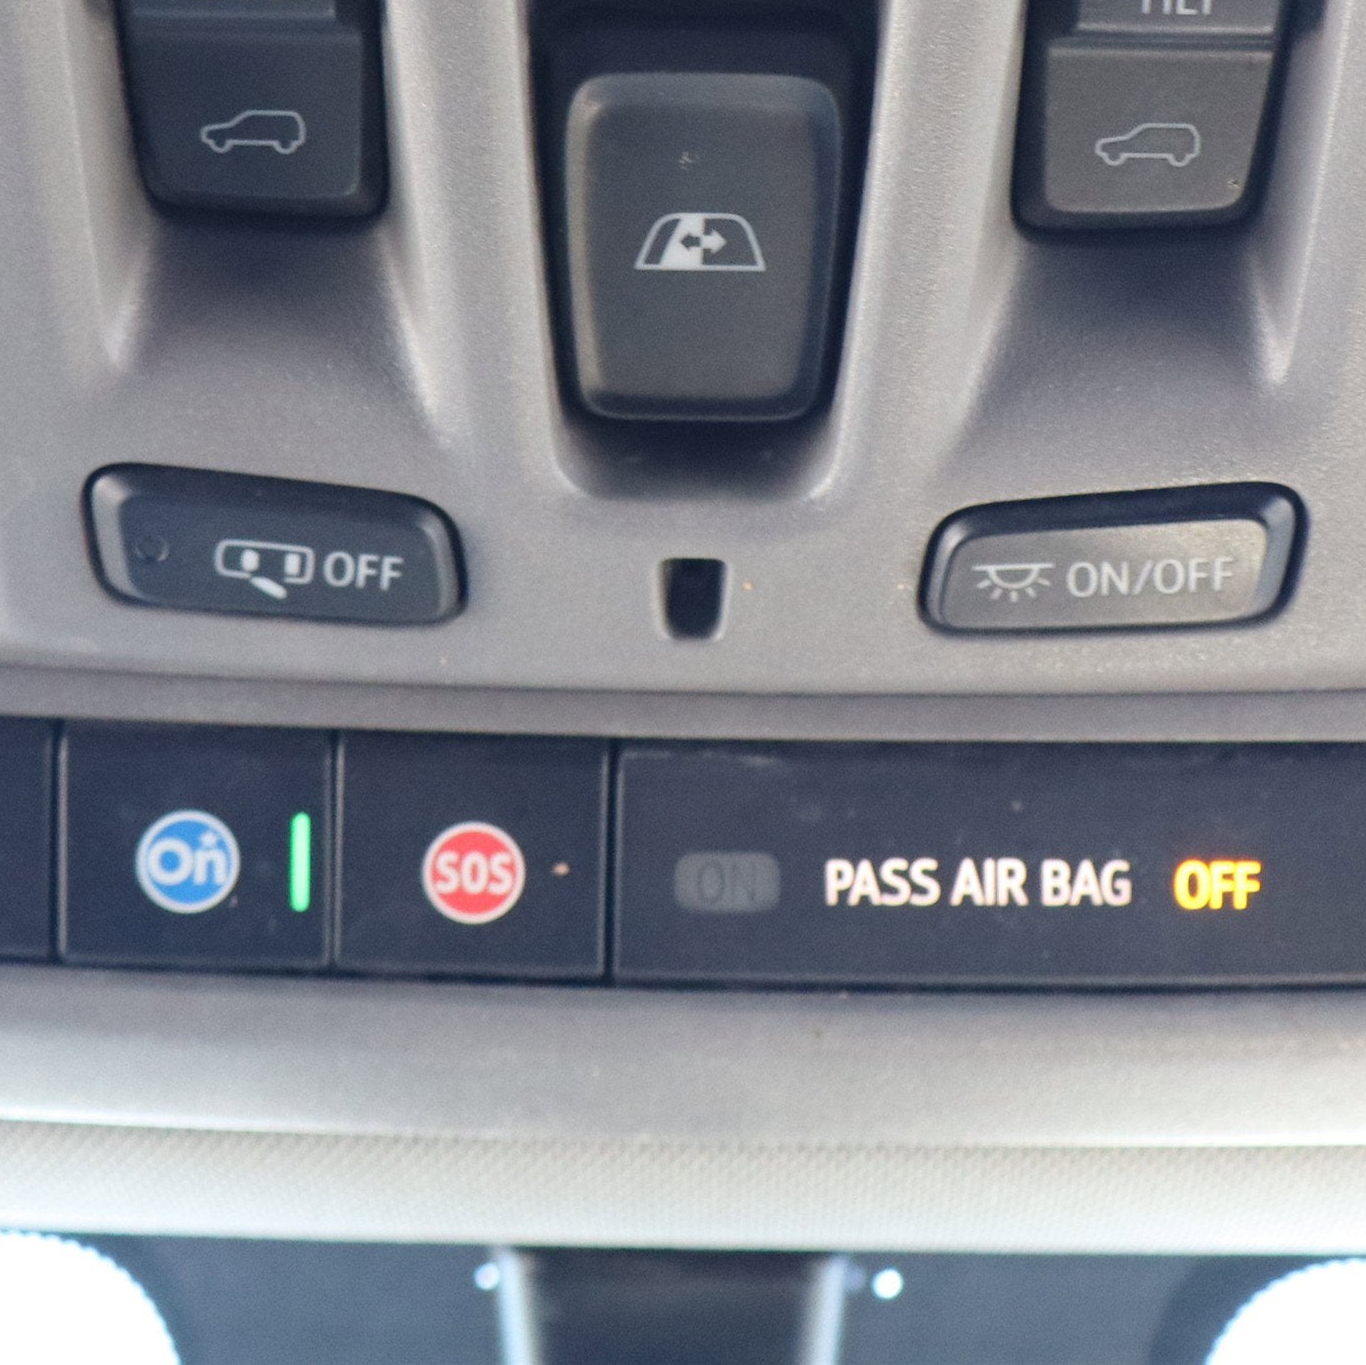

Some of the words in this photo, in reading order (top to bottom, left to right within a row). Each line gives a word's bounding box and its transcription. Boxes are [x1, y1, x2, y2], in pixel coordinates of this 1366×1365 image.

[323, 551, 405, 590] OFF
[1066, 557, 1236, 597] ON/OFF
[434, 850, 515, 896] SOS
[699, 862, 760, 906] ON
[823, 857, 940, 907] PASS
[949, 857, 1029, 907] AIR
[1040, 858, 1132, 908] BAG
[1172, 858, 1262, 910] OFF
